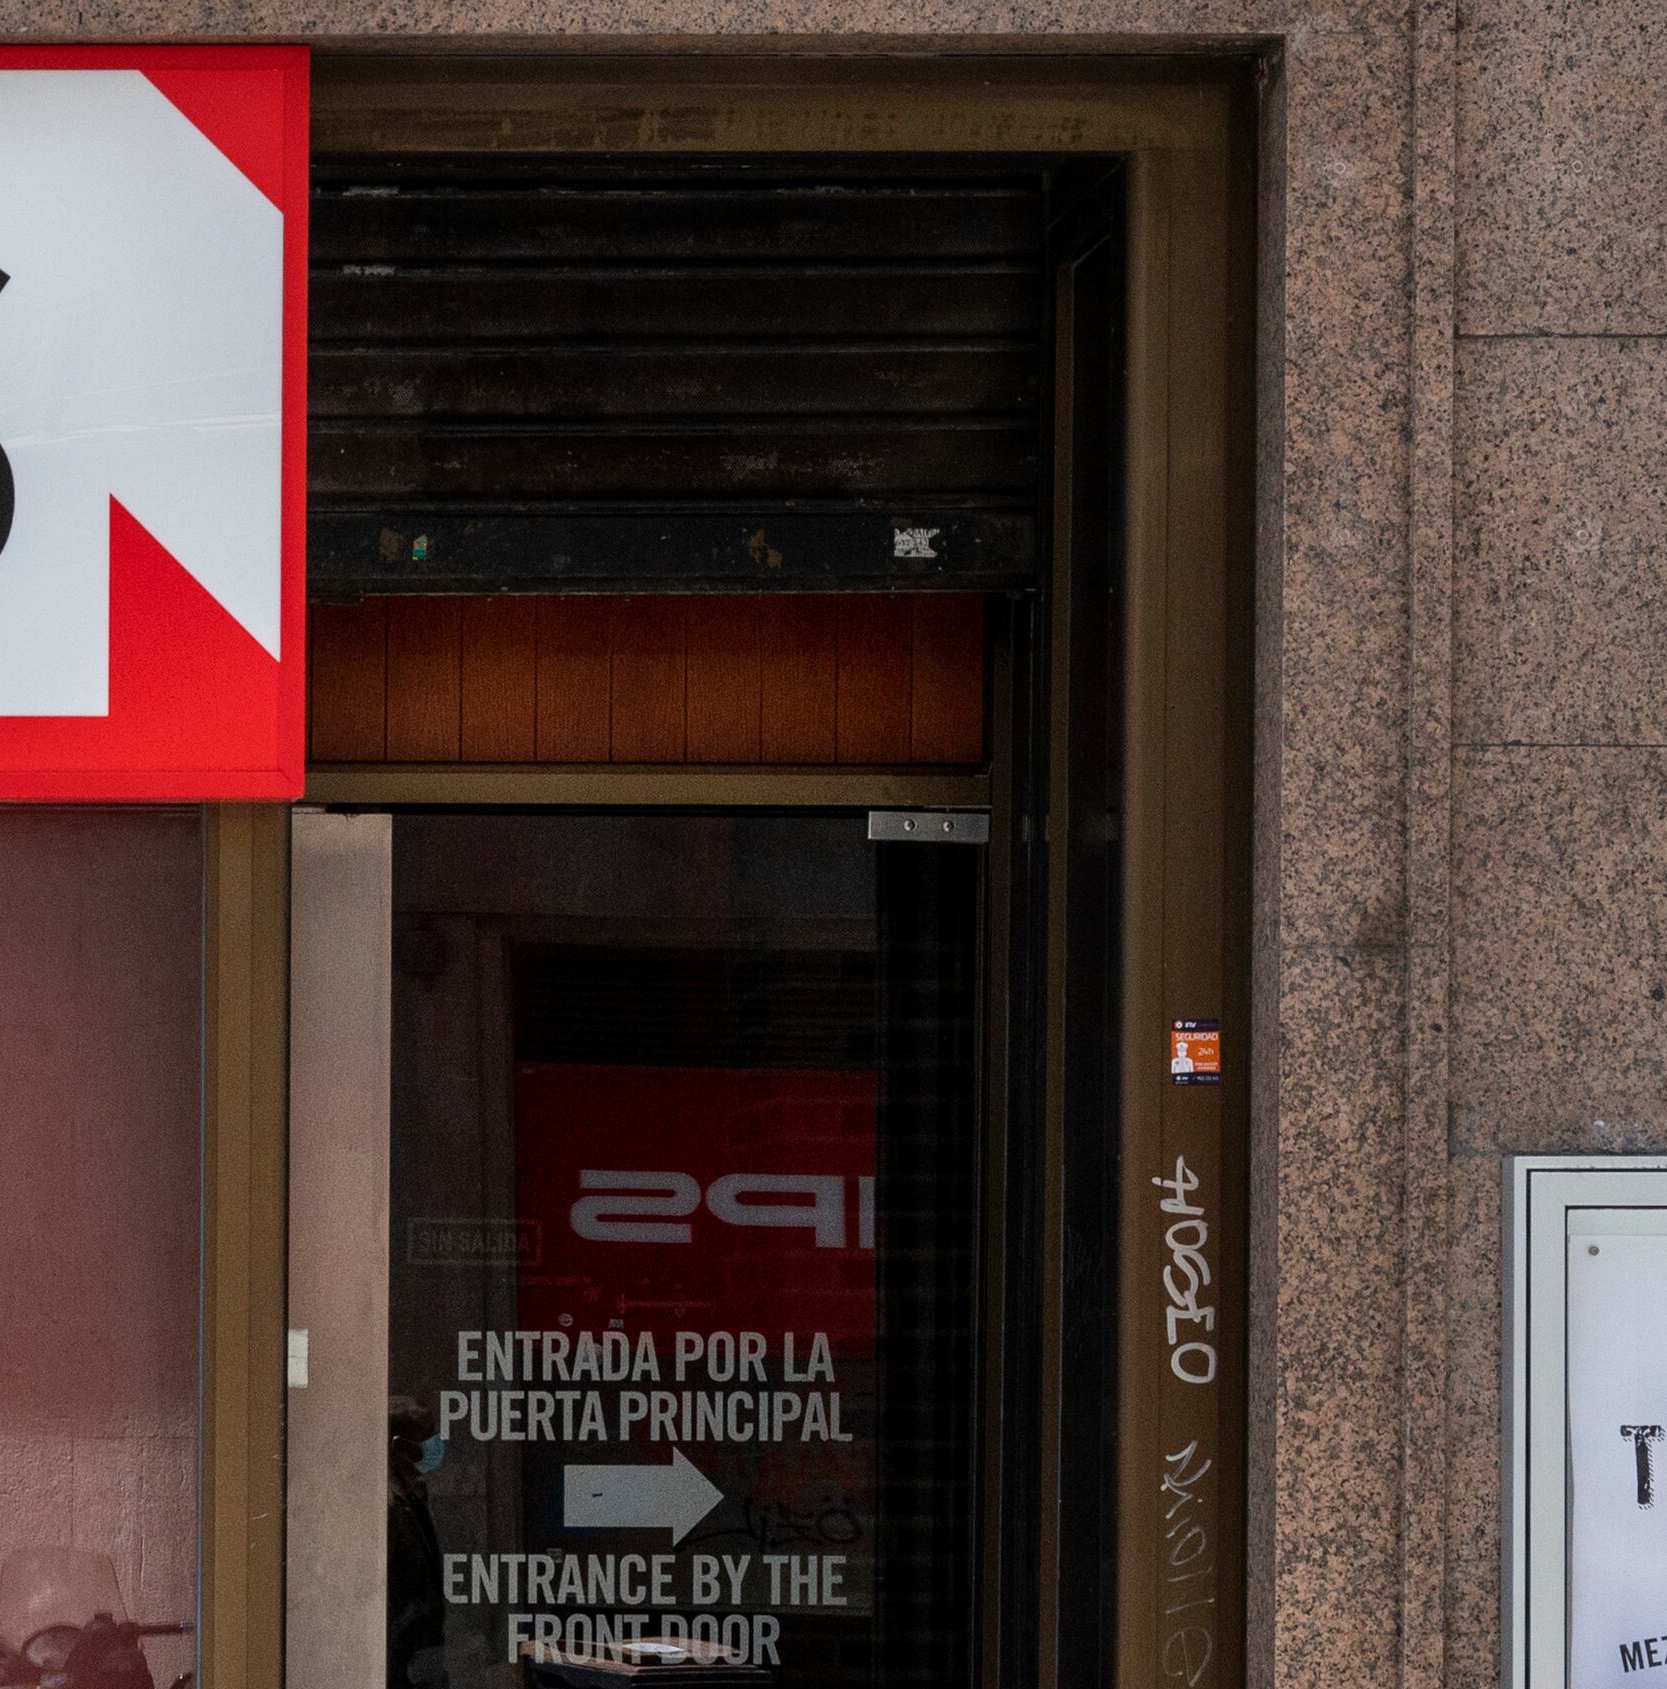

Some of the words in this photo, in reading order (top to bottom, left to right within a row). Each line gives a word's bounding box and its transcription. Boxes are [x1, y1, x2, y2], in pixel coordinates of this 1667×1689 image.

[1175, 1032, 1219, 1041] SEGURIDAD
[456, 1330, 661, 1383] ENTRADA
[674, 1331, 768, 1383] POR
[783, 1331, 836, 1383] LA
[439, 1390, 609, 1442] PUERTA
[626, 1391, 854, 1443] PRINCIPAL
[442, 1553, 676, 1605] ENTRANCE
[692, 1554, 751, 1606] BY
[762, 1554, 848, 1607] THE
[507, 1613, 650, 1665] FRONT
[660, 1613, 782, 1666] DOOR
